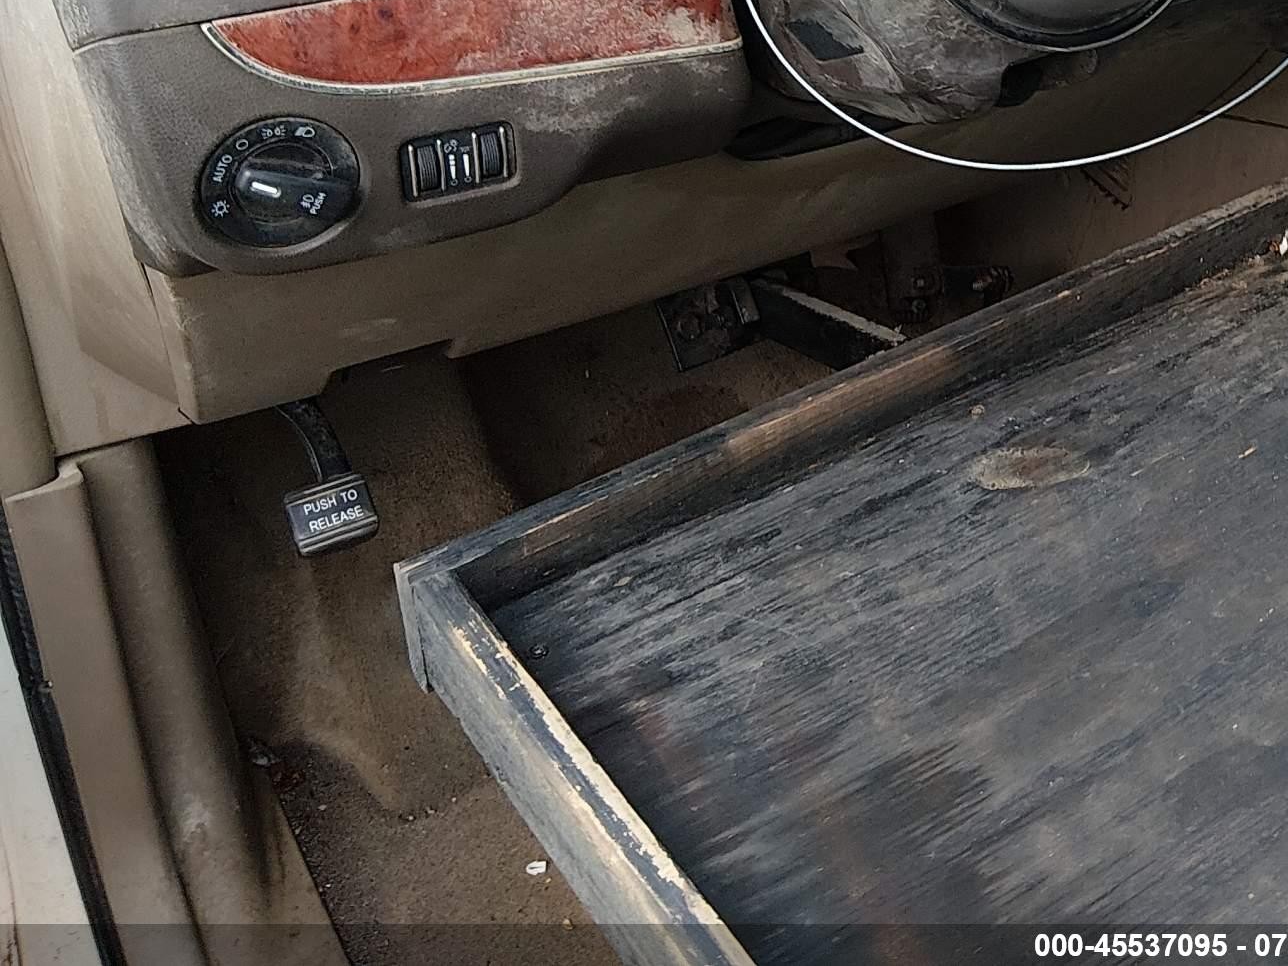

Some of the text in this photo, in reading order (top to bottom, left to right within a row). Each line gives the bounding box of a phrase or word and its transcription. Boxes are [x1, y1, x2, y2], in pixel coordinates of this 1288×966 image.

[212, 154, 233, 182] AUTO
[310, 192, 327, 215] PUSH
[303, 489, 358, 515] PUSH TO
[308, 505, 364, 533] RELEASE
